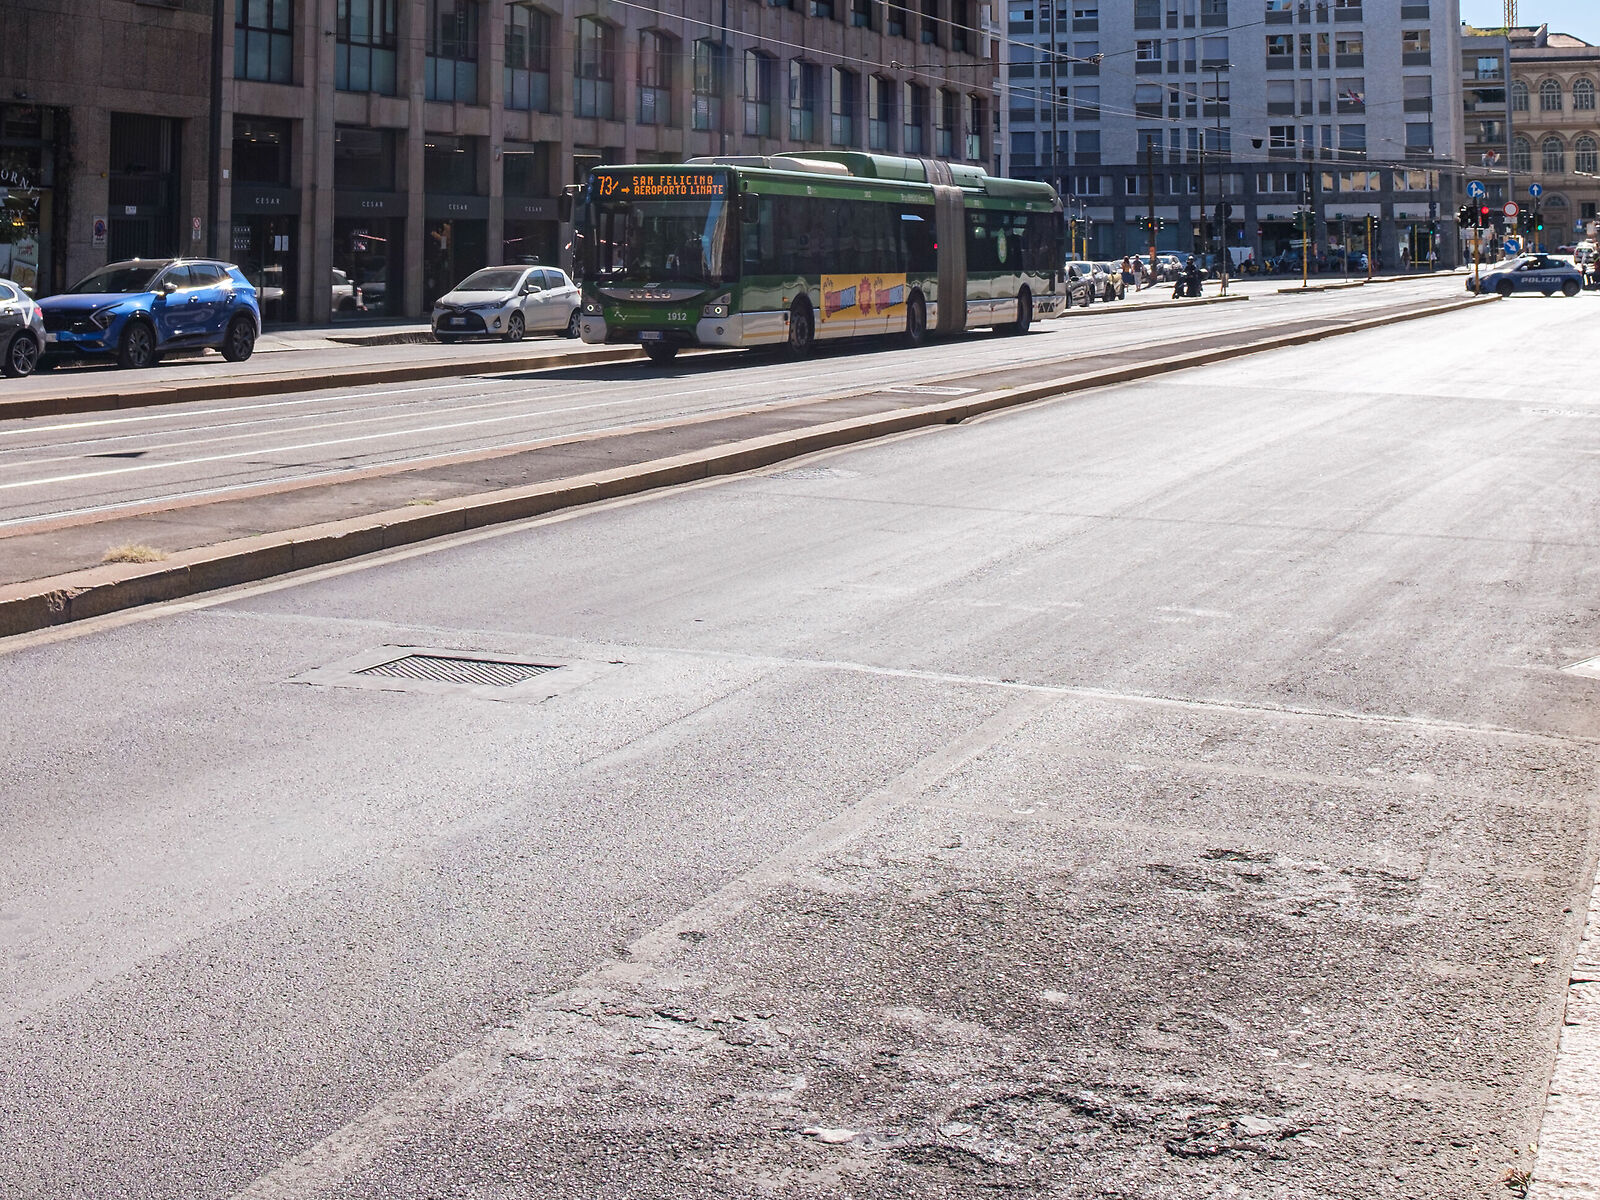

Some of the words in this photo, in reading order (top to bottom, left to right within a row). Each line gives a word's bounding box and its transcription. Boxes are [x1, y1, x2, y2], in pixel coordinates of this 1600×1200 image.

[633, 176, 654, 185] SAN
[660, 176, 713, 185] FELICINO
[634, 185, 687, 195] AEROPORTO
[690, 185, 724, 195] LINATE
[630, 288, 671, 299] IVECO
[667, 312, 687, 321] 1912
